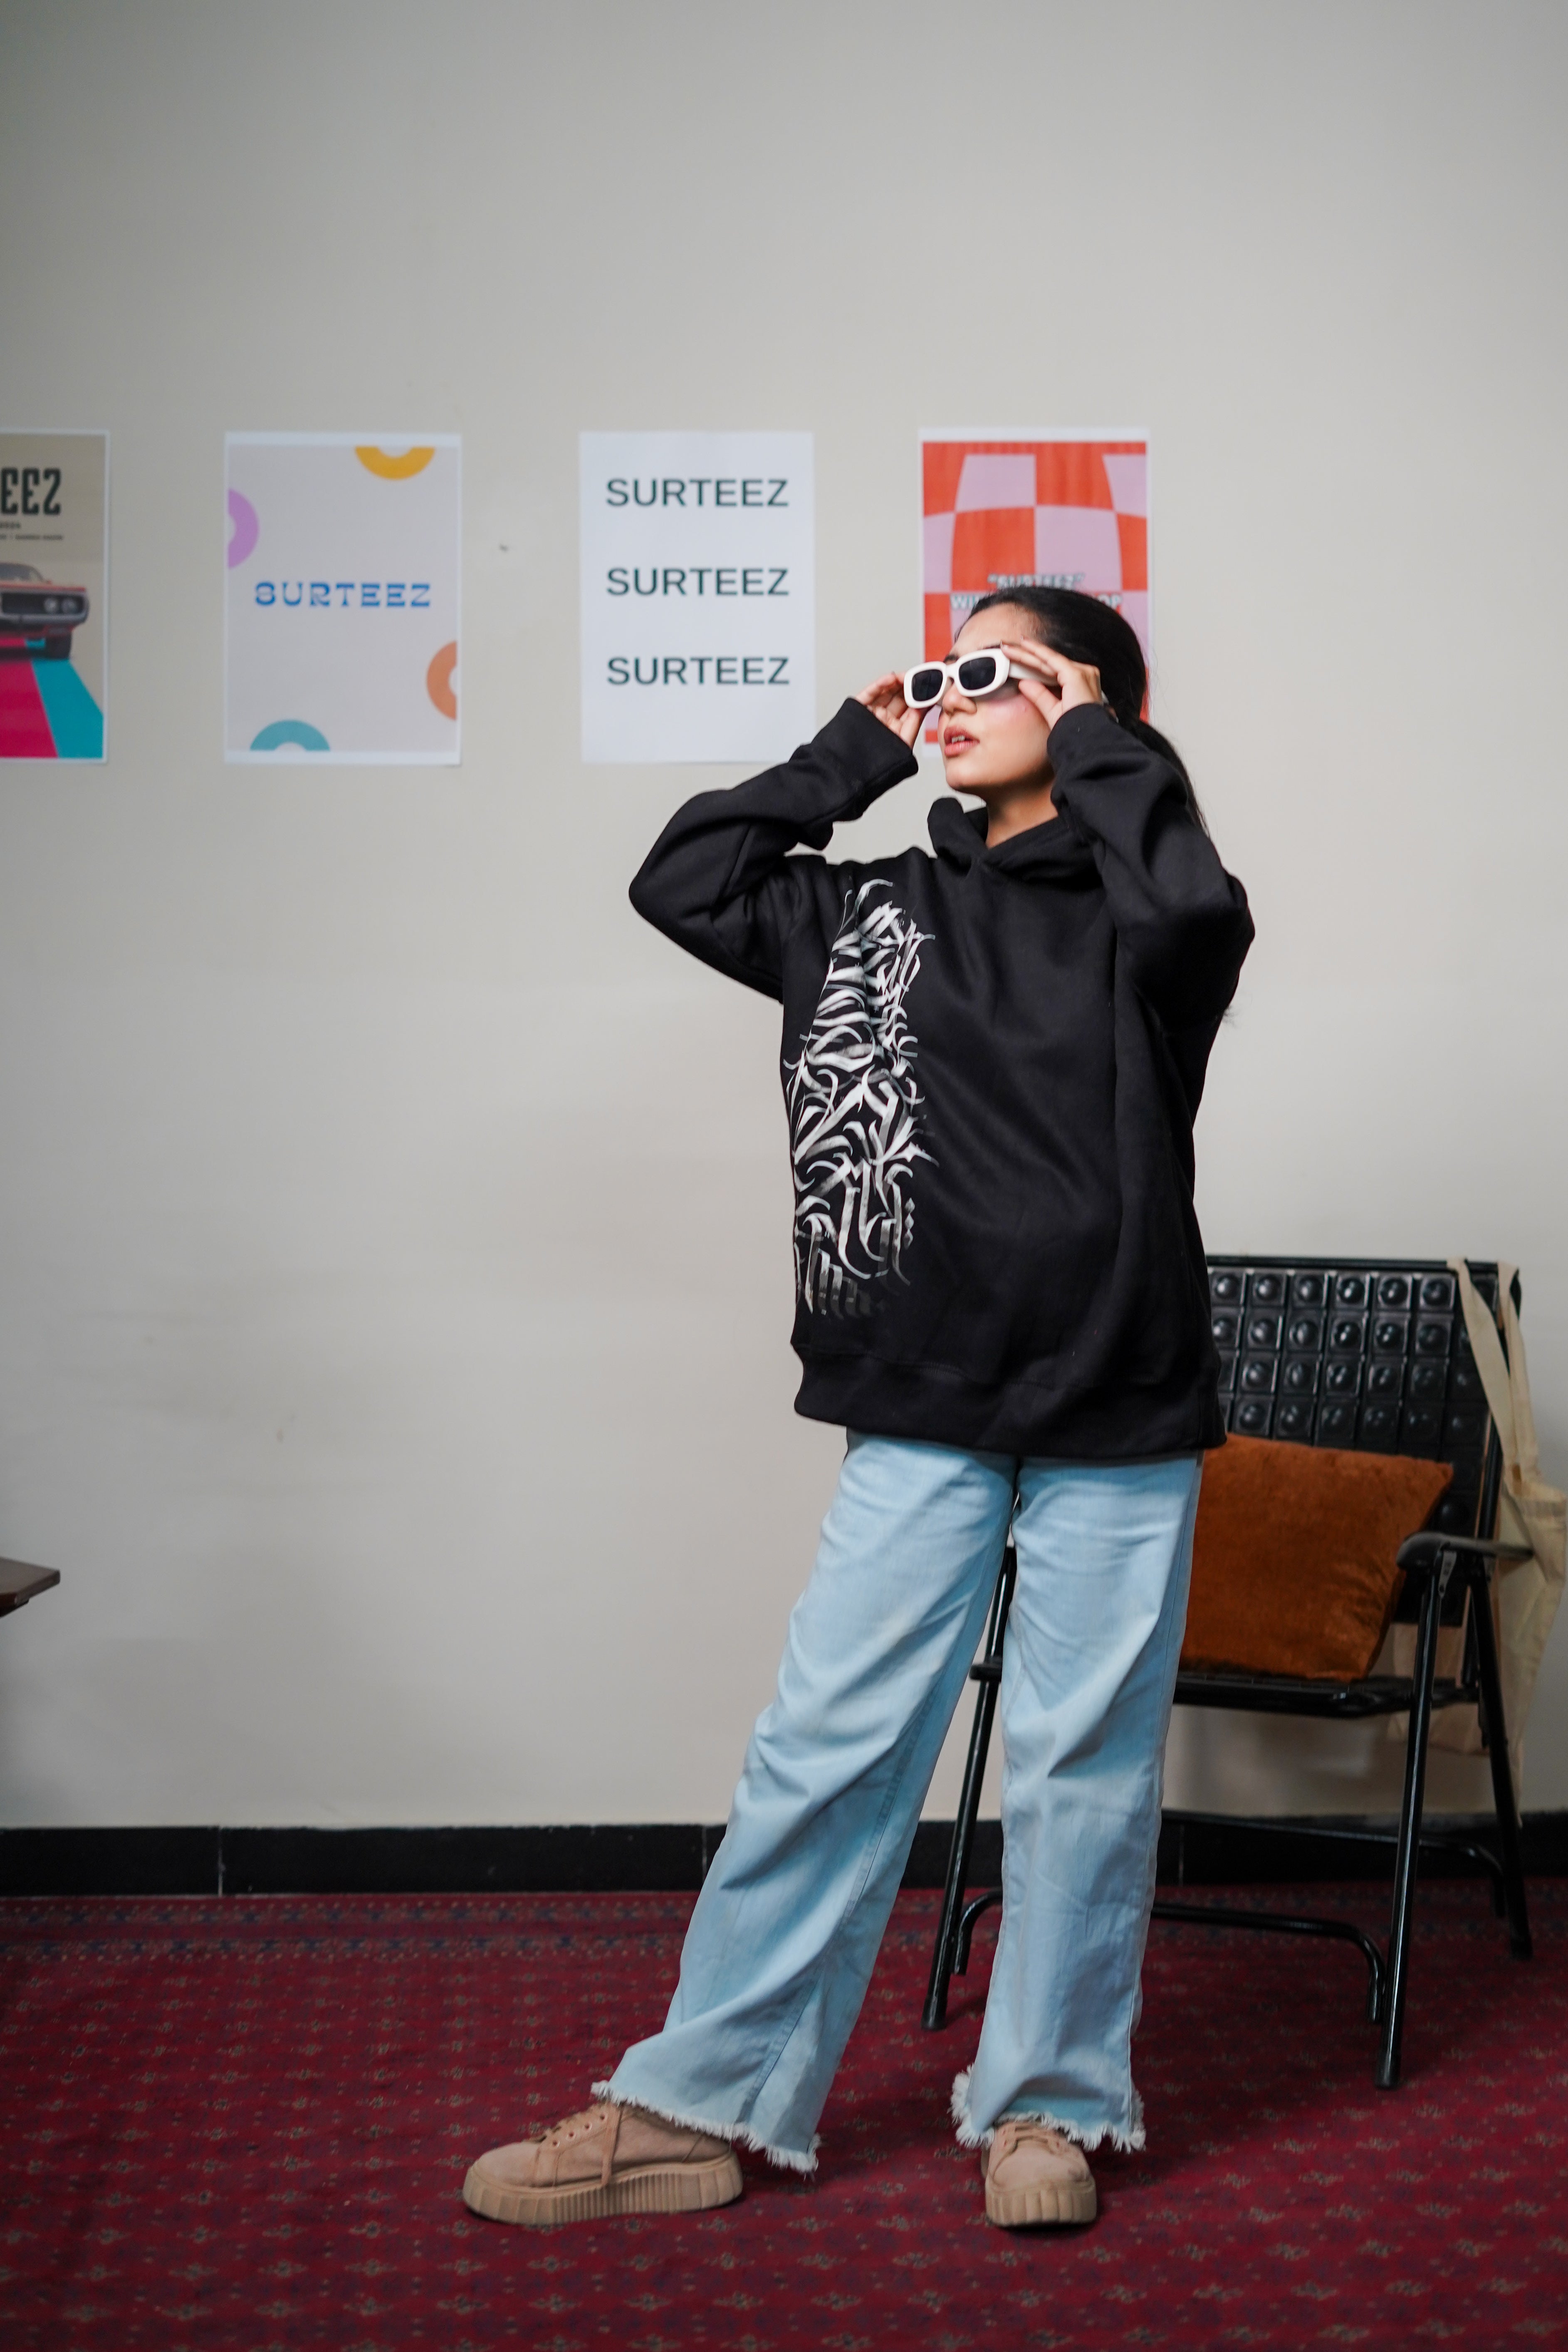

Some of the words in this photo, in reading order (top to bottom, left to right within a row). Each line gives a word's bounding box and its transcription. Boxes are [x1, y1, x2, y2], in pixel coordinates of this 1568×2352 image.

[606, 478, 788, 507] SURTEEZ
[255, 581, 430, 608] SURTEEZ
[607, 568, 789, 596] SURTEEZ
[608, 657, 789, 685] SURTEEZ
